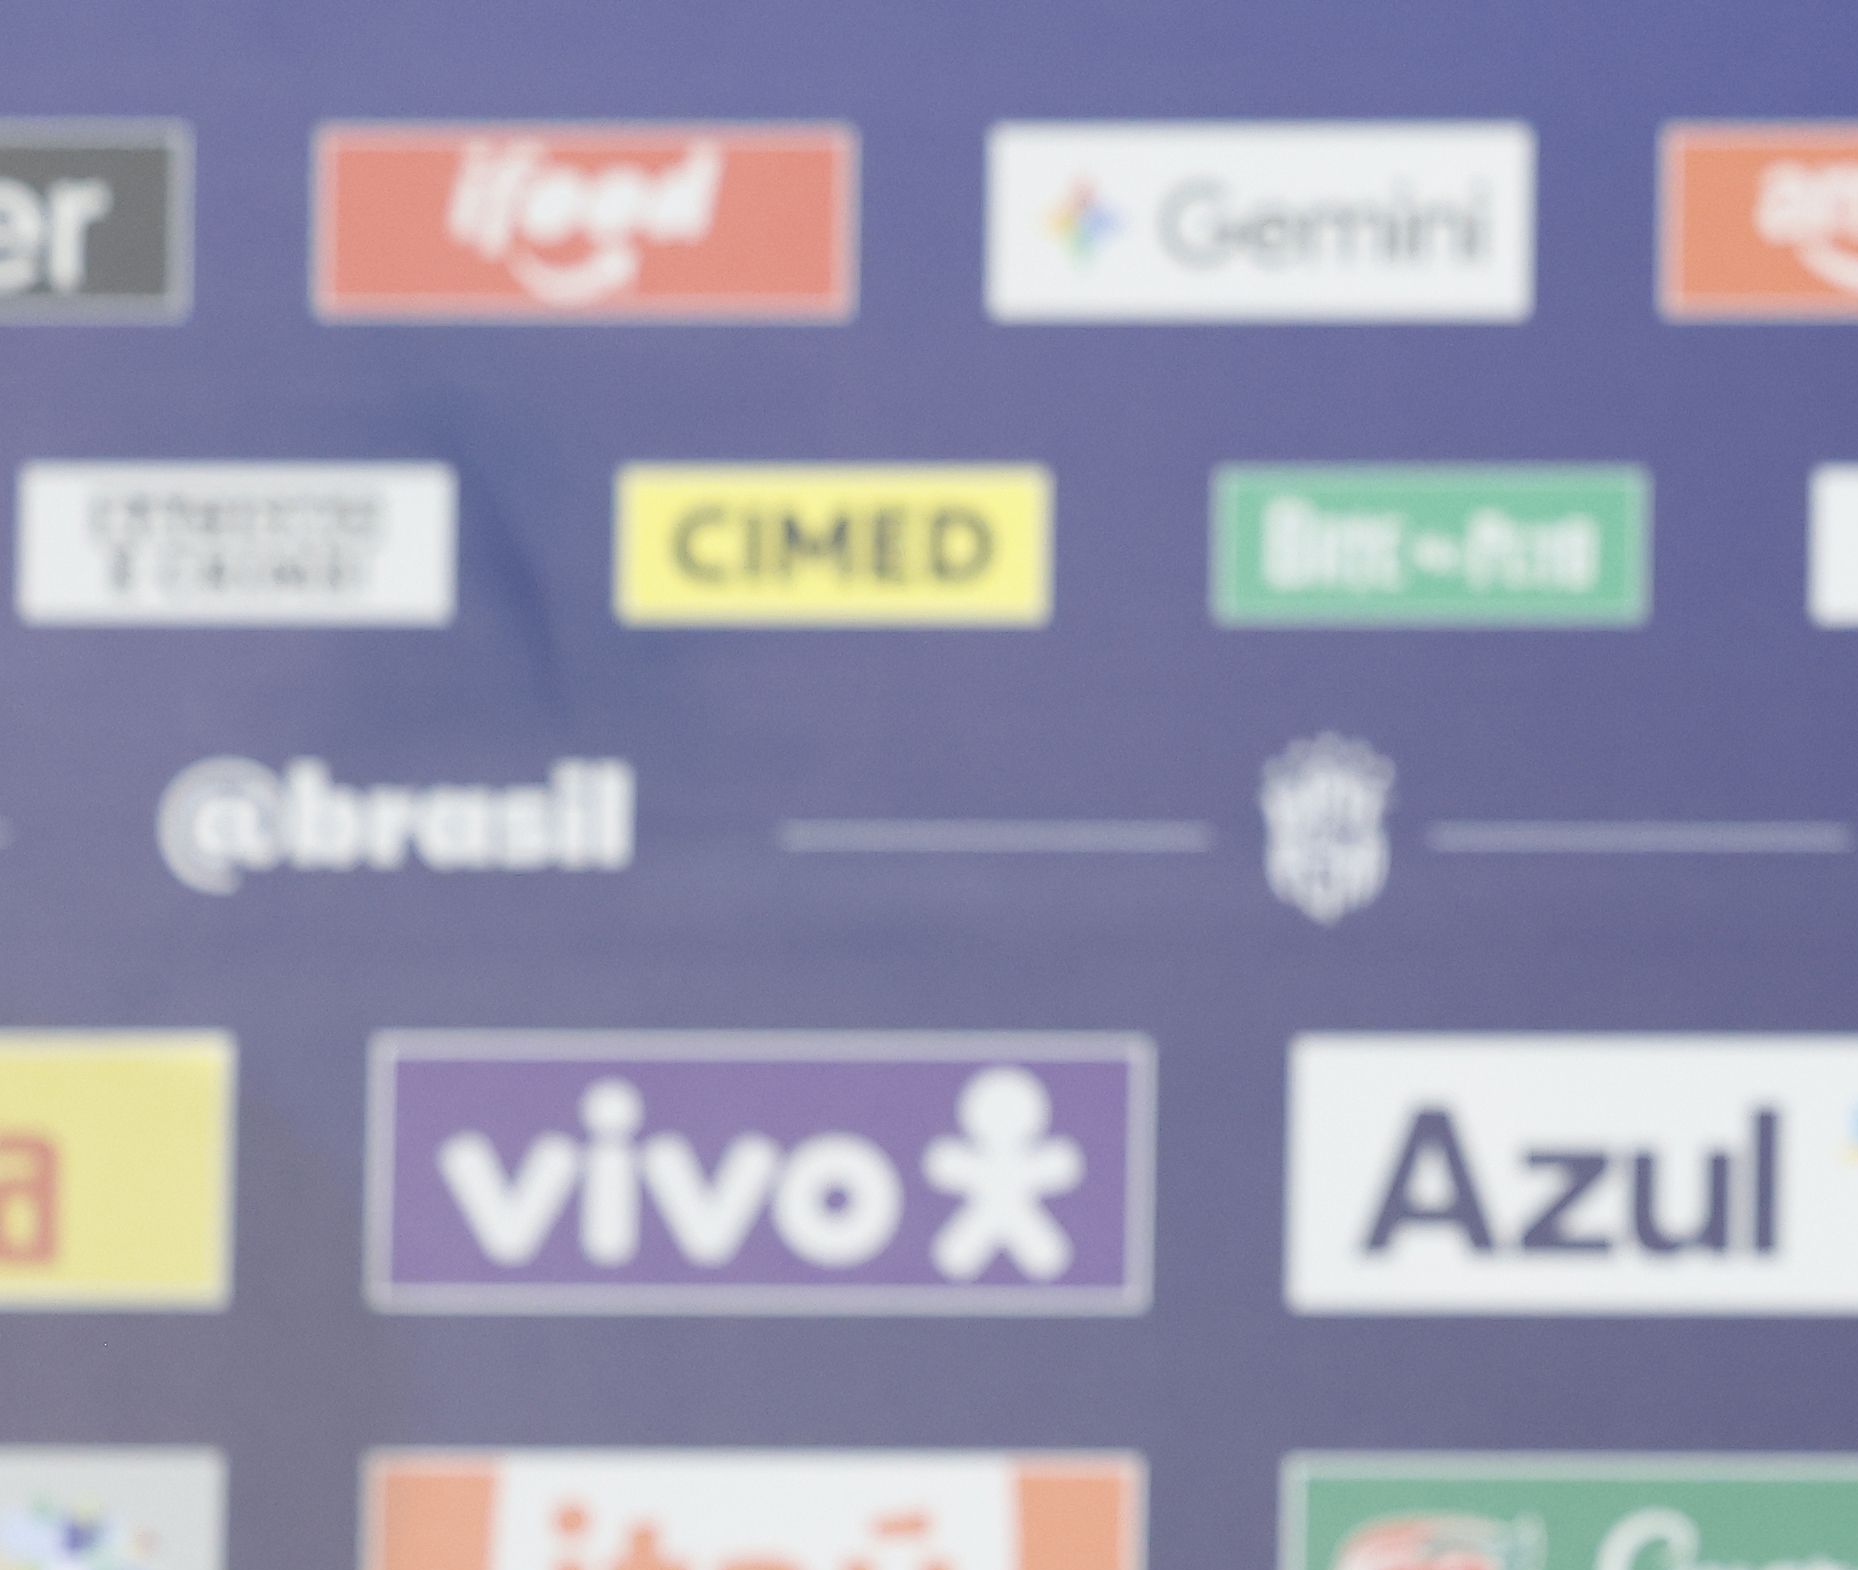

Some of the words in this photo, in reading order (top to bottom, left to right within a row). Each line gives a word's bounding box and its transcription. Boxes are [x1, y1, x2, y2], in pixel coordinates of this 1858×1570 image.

[1155, 168, 1492, 271] Gemini
[668, 503, 997, 587] CIMED
[157, 753, 638, 894] @brasil
[436, 1078, 904, 1268] vivo
[1360, 1103, 1782, 1261] Azul
